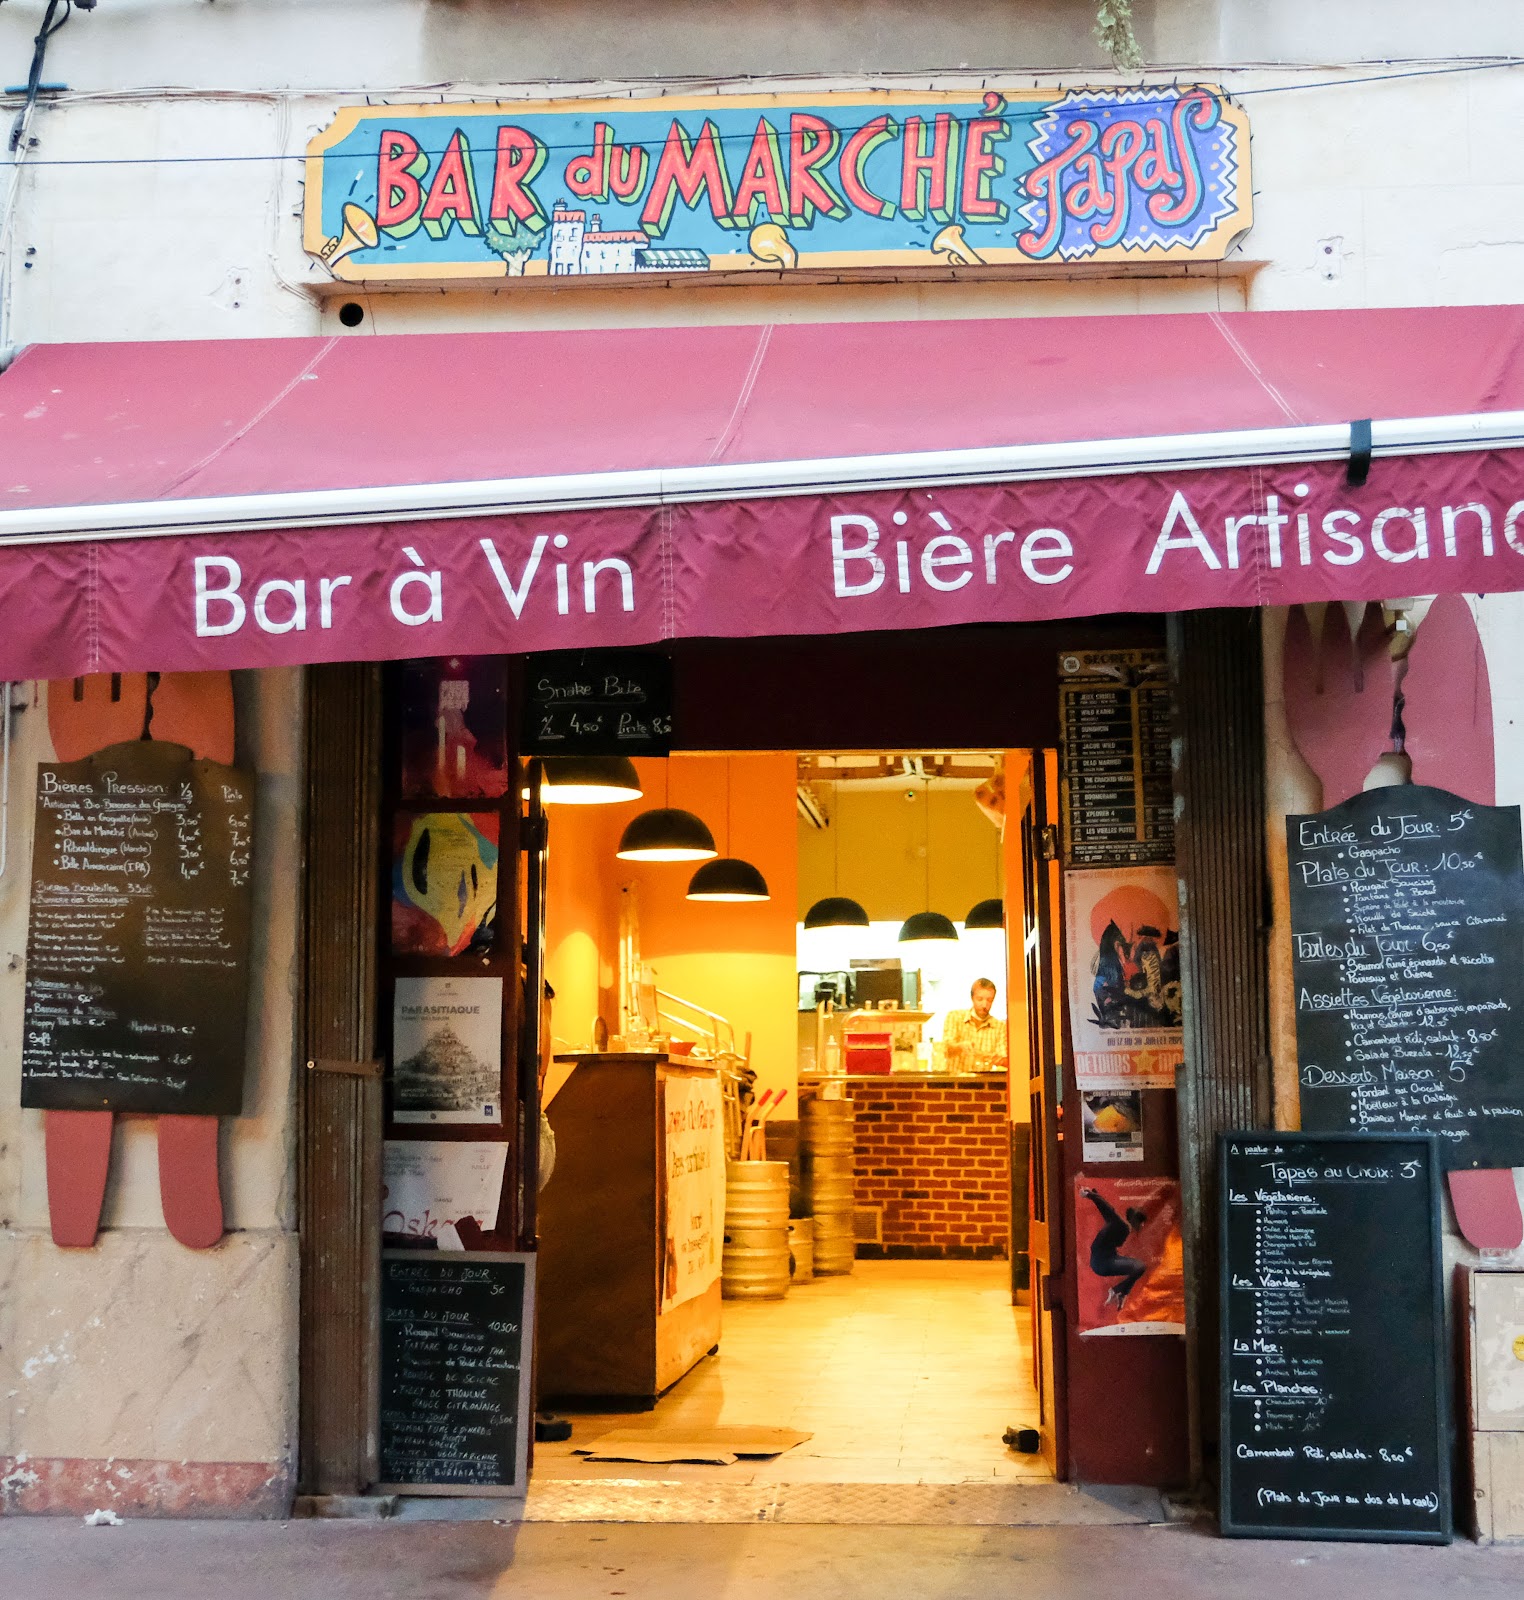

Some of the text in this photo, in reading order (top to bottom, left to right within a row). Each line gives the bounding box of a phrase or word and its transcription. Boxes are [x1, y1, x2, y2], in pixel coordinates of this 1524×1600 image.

[376, 124, 547, 239] BAR
[565, 122, 651, 207] du
[643, 92, 1011, 237] MARCHÉ
[829, 509, 1075, 599] Bière
[194, 534, 637, 637] Bar à Vin
[42, 772, 94, 794] Bières
[1370, 815, 1392, 836] du
[401, 1005, 480, 1015] PARASITIAQUE
[1230, 1143, 1239, 1154] A
[1260, 1161, 1319, 1188] Tapas
[1323, 1167, 1344, 1178] au
[1229, 1188, 1249, 1203] Les
[1232, 1273, 1253, 1287] Les
[1233, 1338, 1250, 1352] La
[1232, 1379, 1257, 1394] Les
[1297, 1492, 1311, 1505] du
[1345, 1495, 1360, 1505] au
[1363, 1492, 1383, 1506] dos
